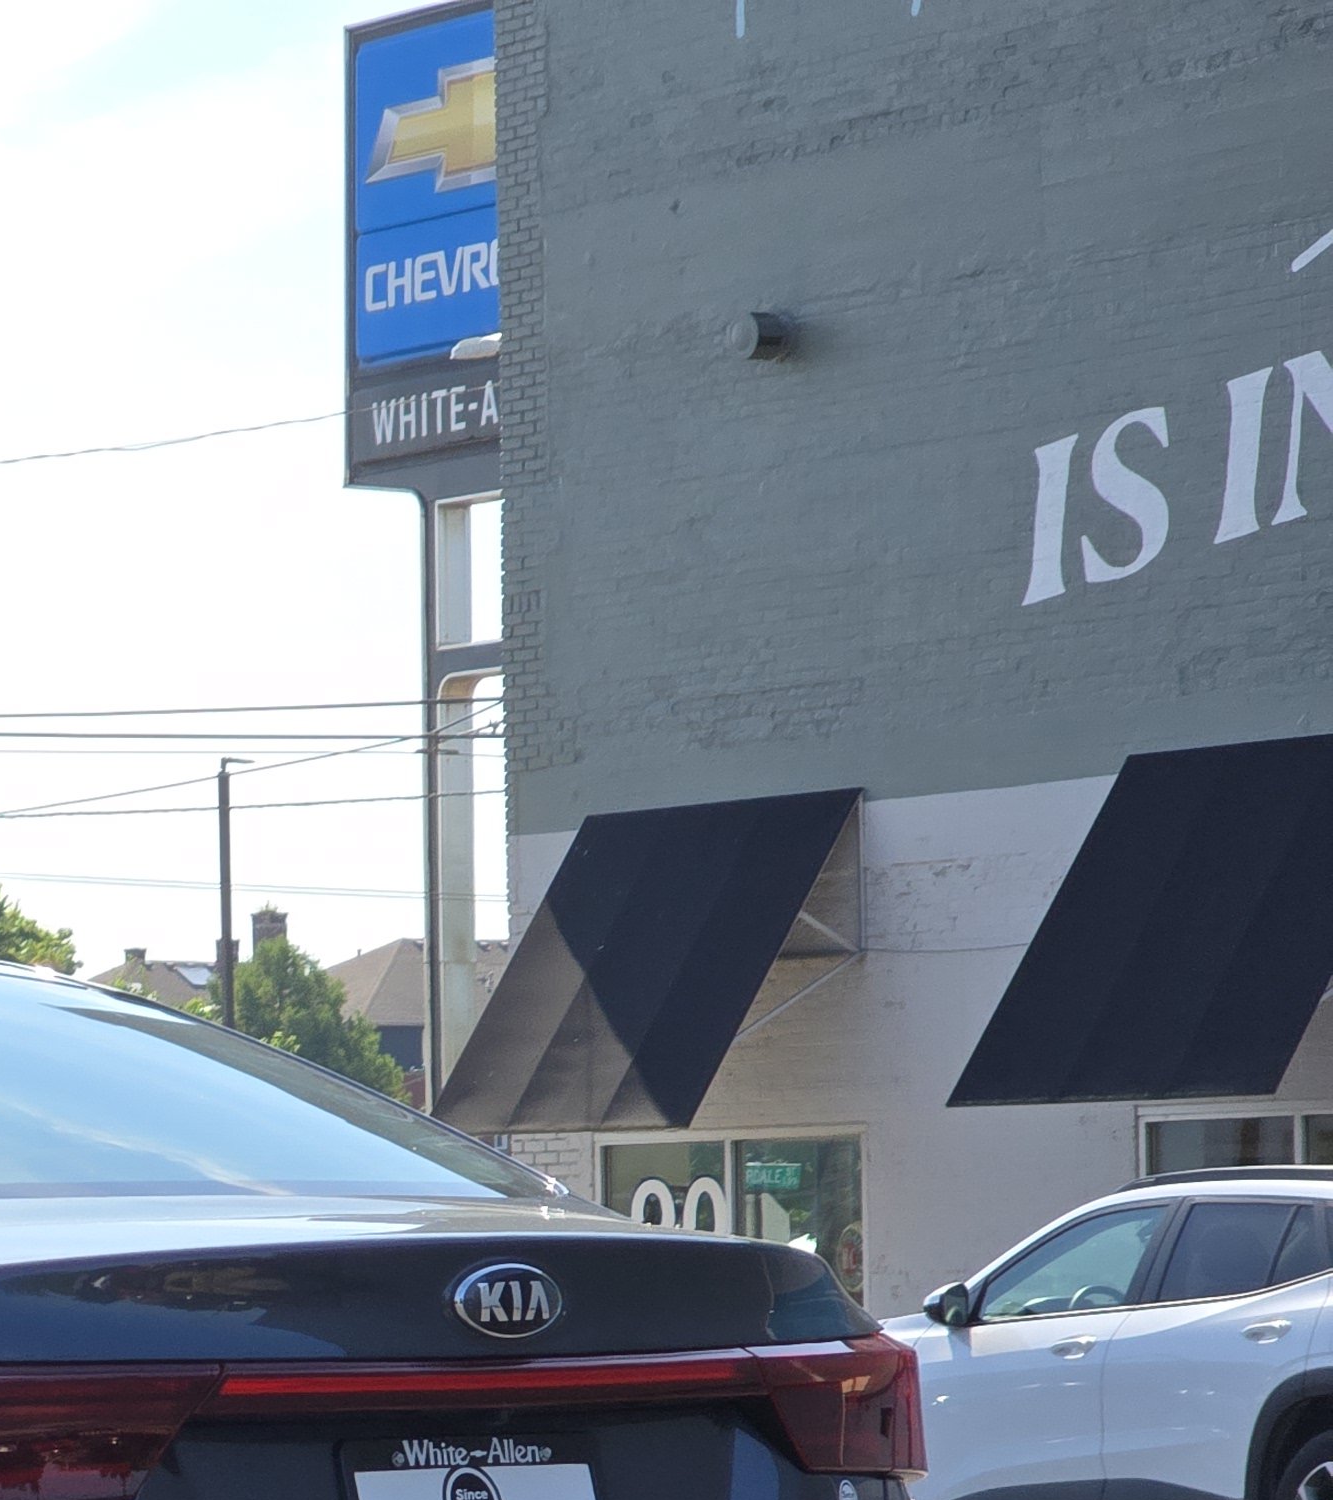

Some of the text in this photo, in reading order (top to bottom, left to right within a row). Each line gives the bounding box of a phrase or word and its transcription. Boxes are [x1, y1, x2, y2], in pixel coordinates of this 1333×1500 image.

[372, 380, 499, 446] WHITE-A
[1021, 407, 1169, 606] IS
[477, 1280, 550, 1322] KIA
[455, 1488, 489, 1500] Since
